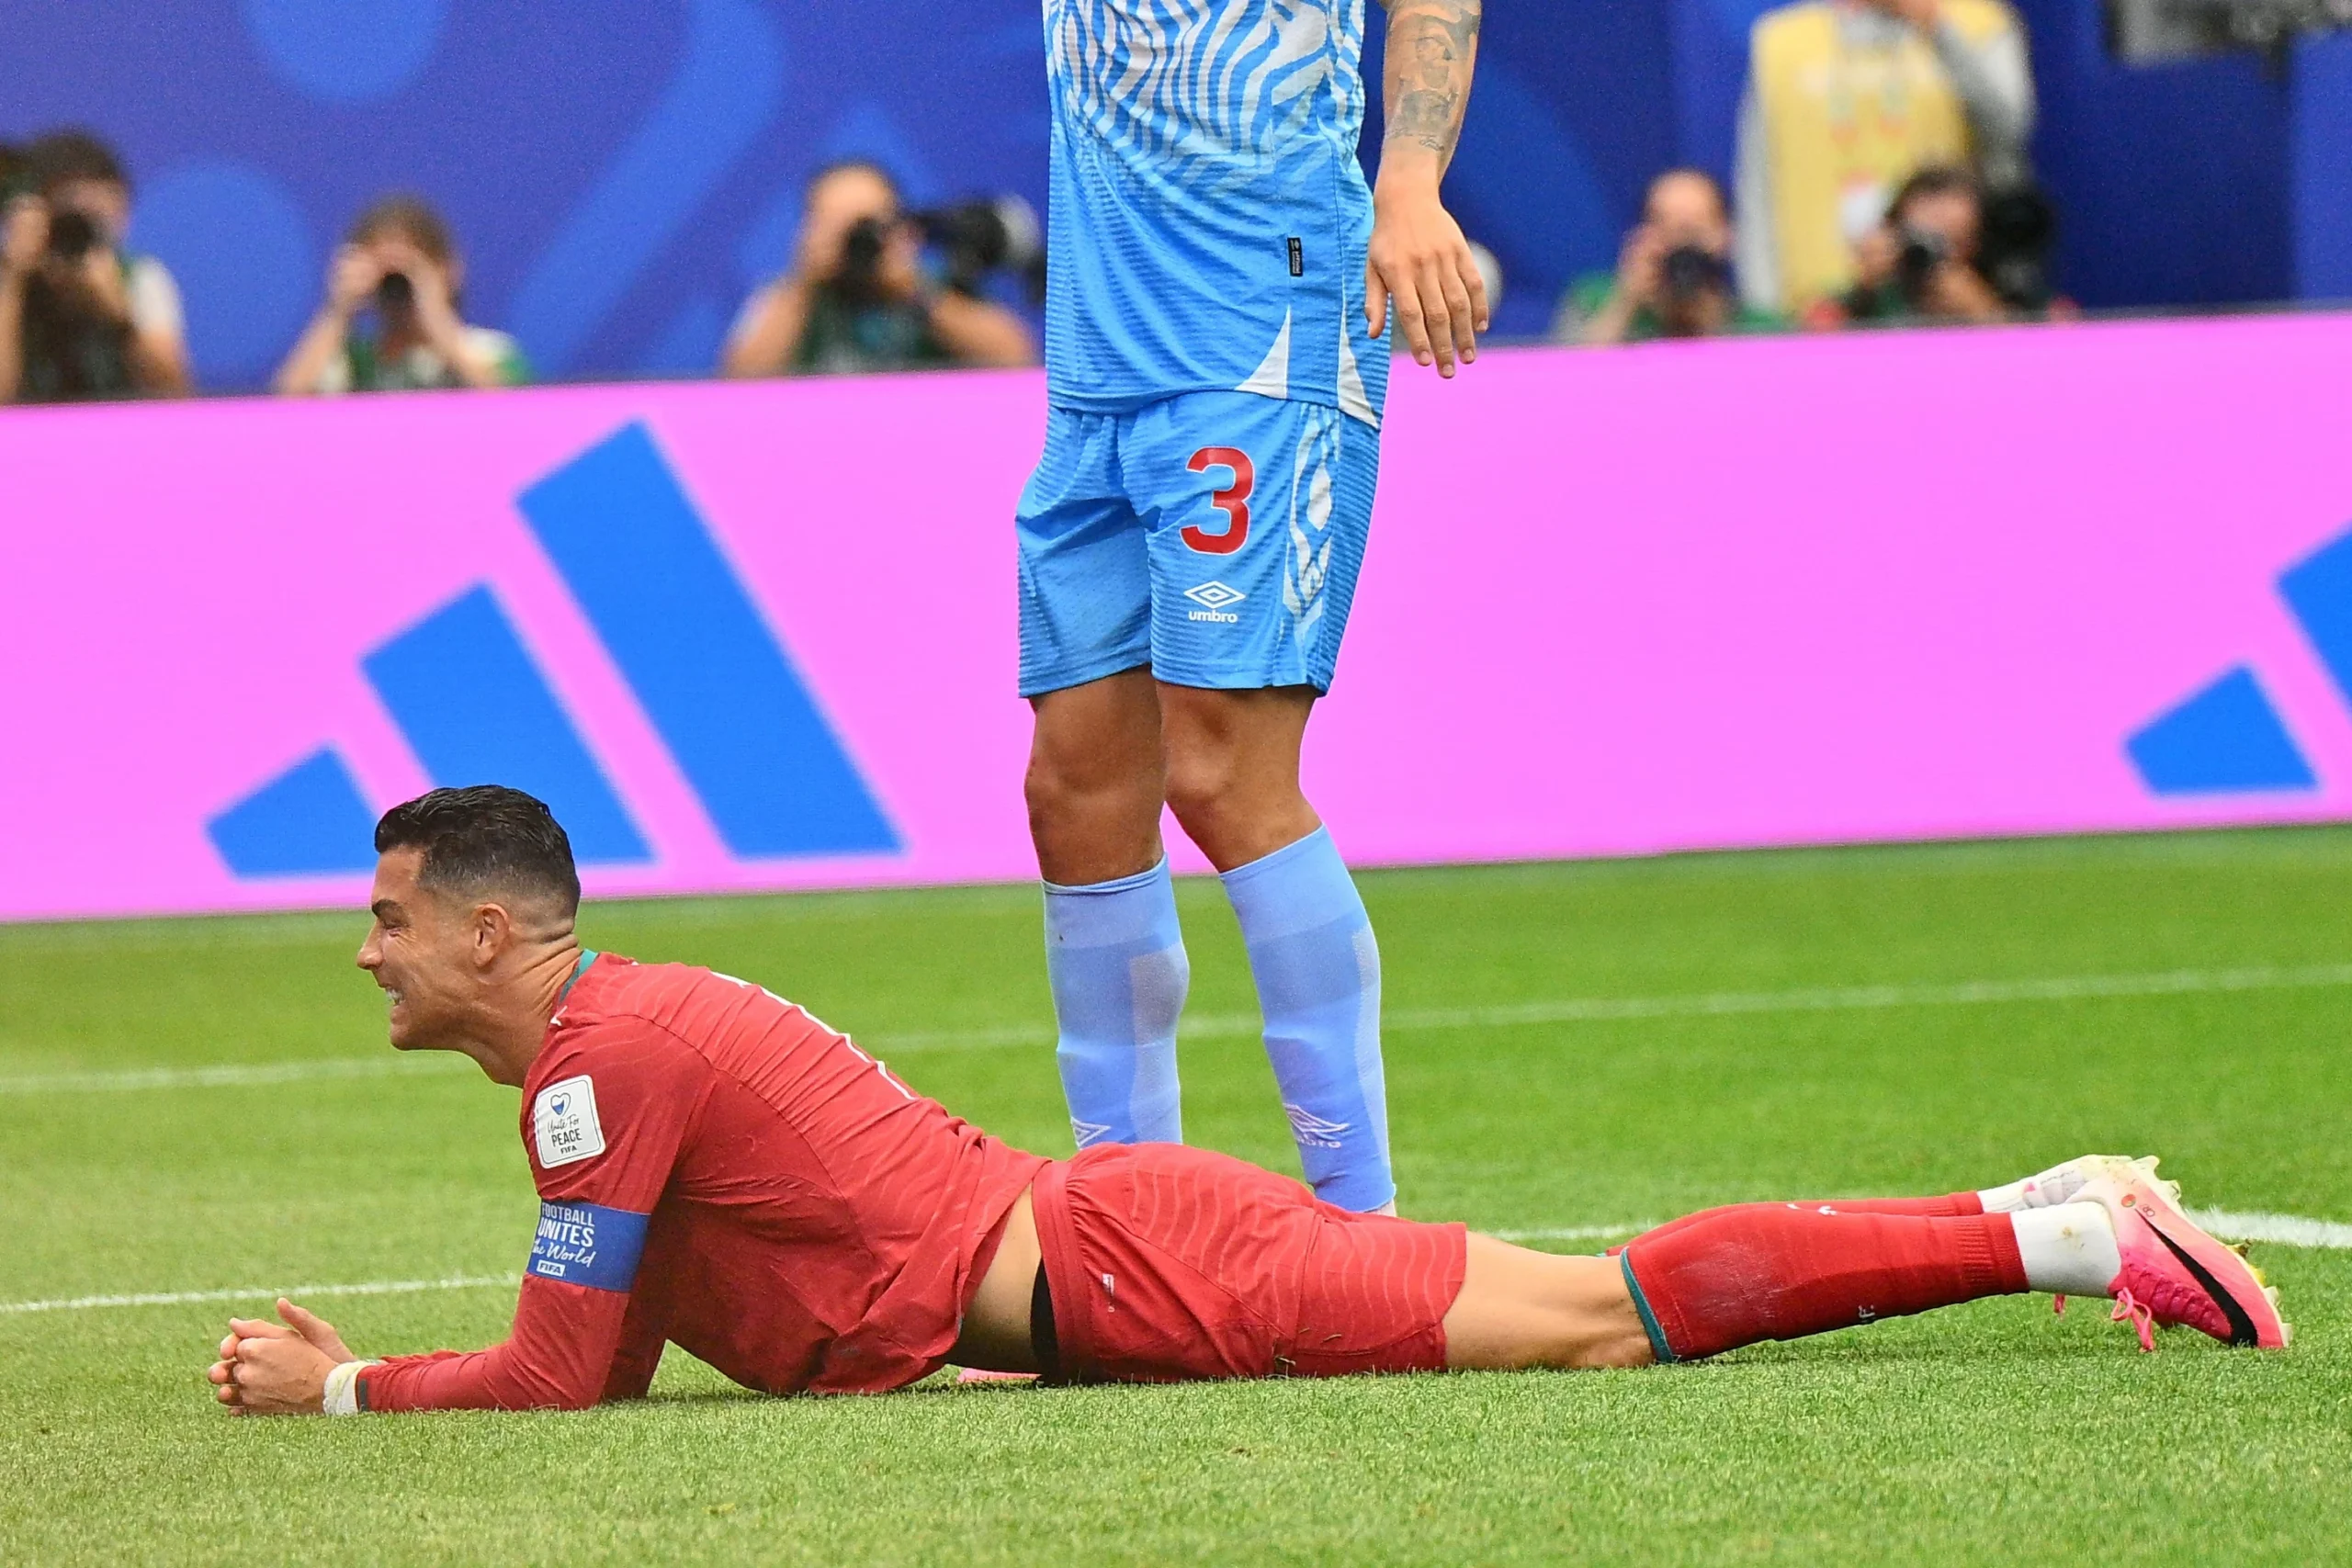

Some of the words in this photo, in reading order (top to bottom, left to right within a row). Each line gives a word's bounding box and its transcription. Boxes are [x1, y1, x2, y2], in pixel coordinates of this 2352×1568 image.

[1180, 446, 1255, 556] 3
[1188, 609, 1238, 624] umbro
[547, 1118, 567, 1134] Unite
[567, 1113, 581, 1126] For
[551, 1128, 582, 1147] PEACE
[560, 1145, 577, 1155] FIFA
[541, 1201, 595, 1227] FOOTBALL
[537, 1217, 595, 1247] UNITES
[546, 1241, 597, 1268] World
[538, 1262, 563, 1275] FIFA
